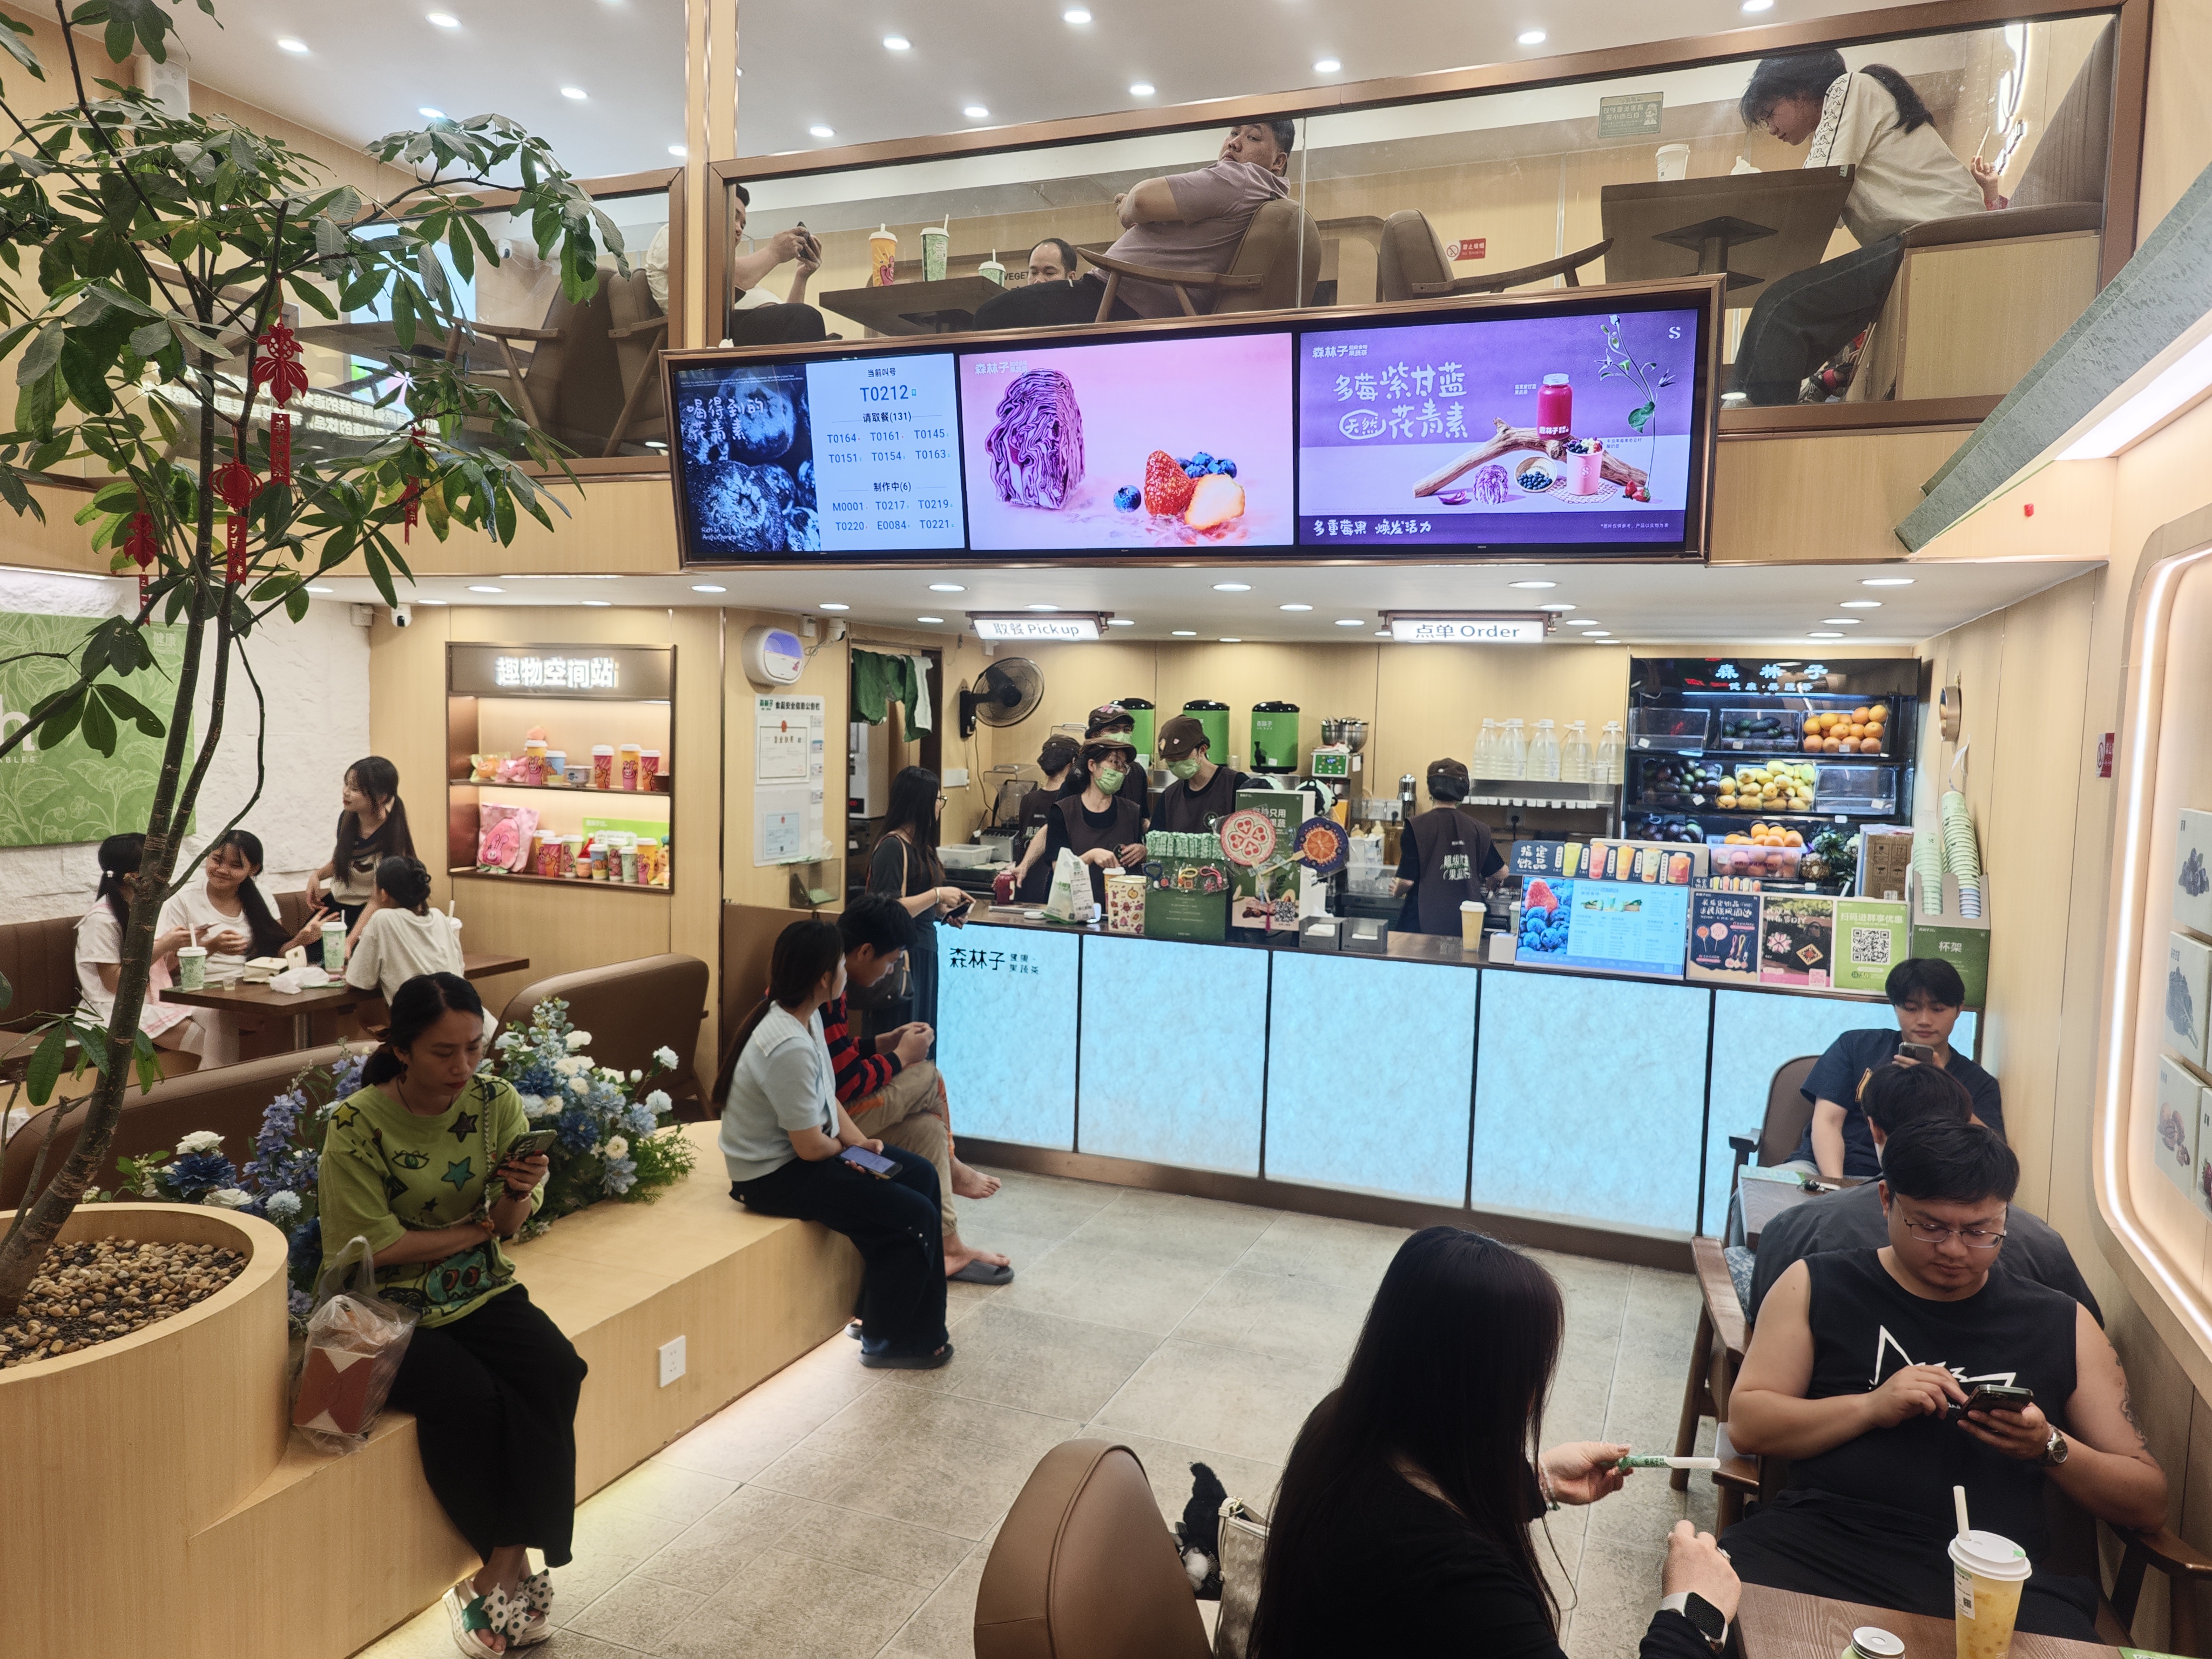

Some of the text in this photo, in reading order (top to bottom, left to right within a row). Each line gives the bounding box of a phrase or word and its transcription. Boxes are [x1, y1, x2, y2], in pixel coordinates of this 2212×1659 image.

[1312, 346, 1348, 358] 森林子
[867, 368, 896, 377] 当前叫号
[975, 361, 1009, 375] 森林子
[1333, 361, 1467, 401] 多莓紫甘蓝
[860, 385, 909, 402] T0212
[683, 396, 764, 420] 喝得到的
[862, 412, 912, 423] 请取餐(131)
[1388, 398, 1468, 439] 花青素
[692, 417, 747, 442] 花青素
[1345, 416, 1379, 435] 天然
[827, 429, 945, 443] T0164 T0161 T0145
[828, 449, 946, 463] T0151 T0154 T0163
[873, 481, 911, 493] 制作中(6)
[832, 499, 949, 511] M0001 T0217 T0219
[835, 520, 949, 531] T0220 E0084 T0221
[1313, 518, 1432, 536] 多重莓果 焕发活力
[994, 623, 1025, 636] 取餐
[1415, 624, 1520, 638] 点单 Order
[152, 631, 176, 647] 健康
[495, 656, 617, 688] 趣物空间站
[1715, 663, 1829, 679] 森林子
[1520, 845, 1548, 859] 指定
[1517, 858, 1548, 870] 饮品
[1840, 912, 1904, 924] 扫码进群享优惠
[1938, 941, 1963, 953] 杯架
[949, 947, 1006, 970] 森林子
